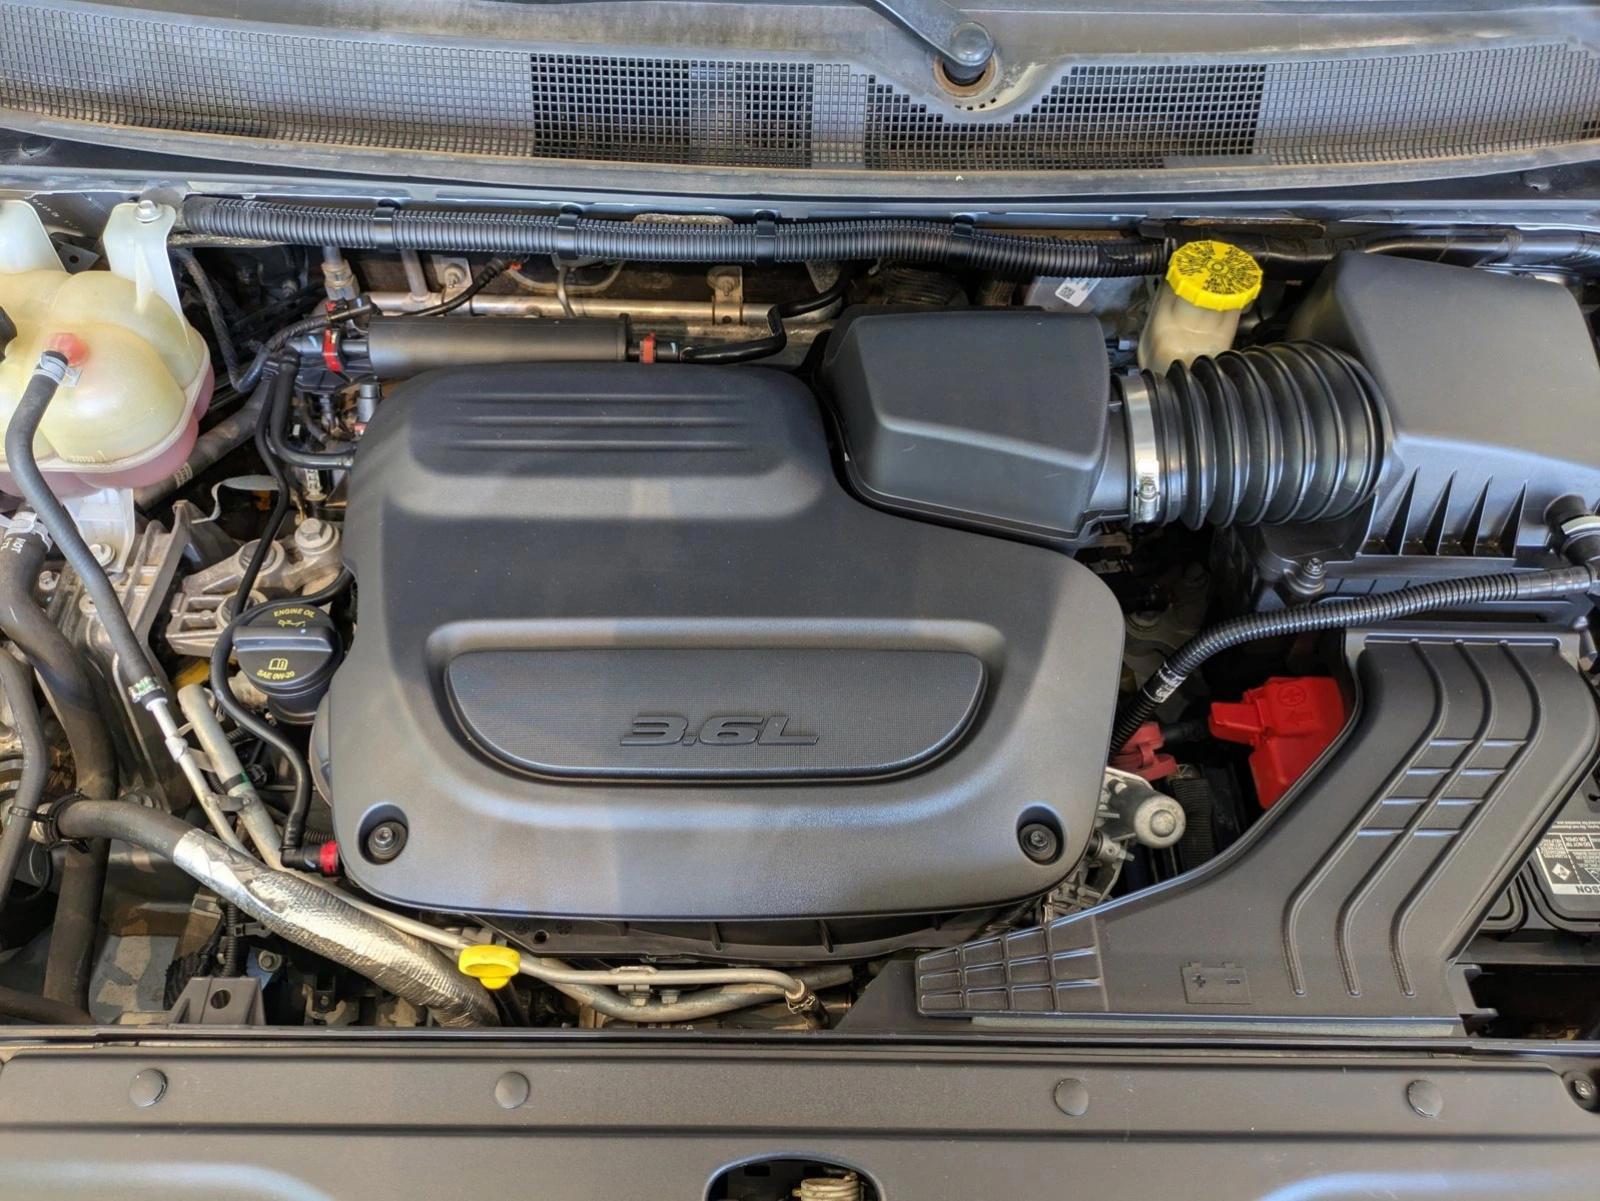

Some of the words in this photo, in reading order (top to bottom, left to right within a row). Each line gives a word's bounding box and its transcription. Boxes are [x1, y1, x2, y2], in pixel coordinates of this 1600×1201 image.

[273, 607, 304, 617] ENGINE
[303, 609, 316, 618] OIL
[256, 669, 272, 679] SAE
[272, 670, 296, 680] 0W-20
[620, 714, 820, 746] 3.6L
[1576, 885, 1600, 894] SON
